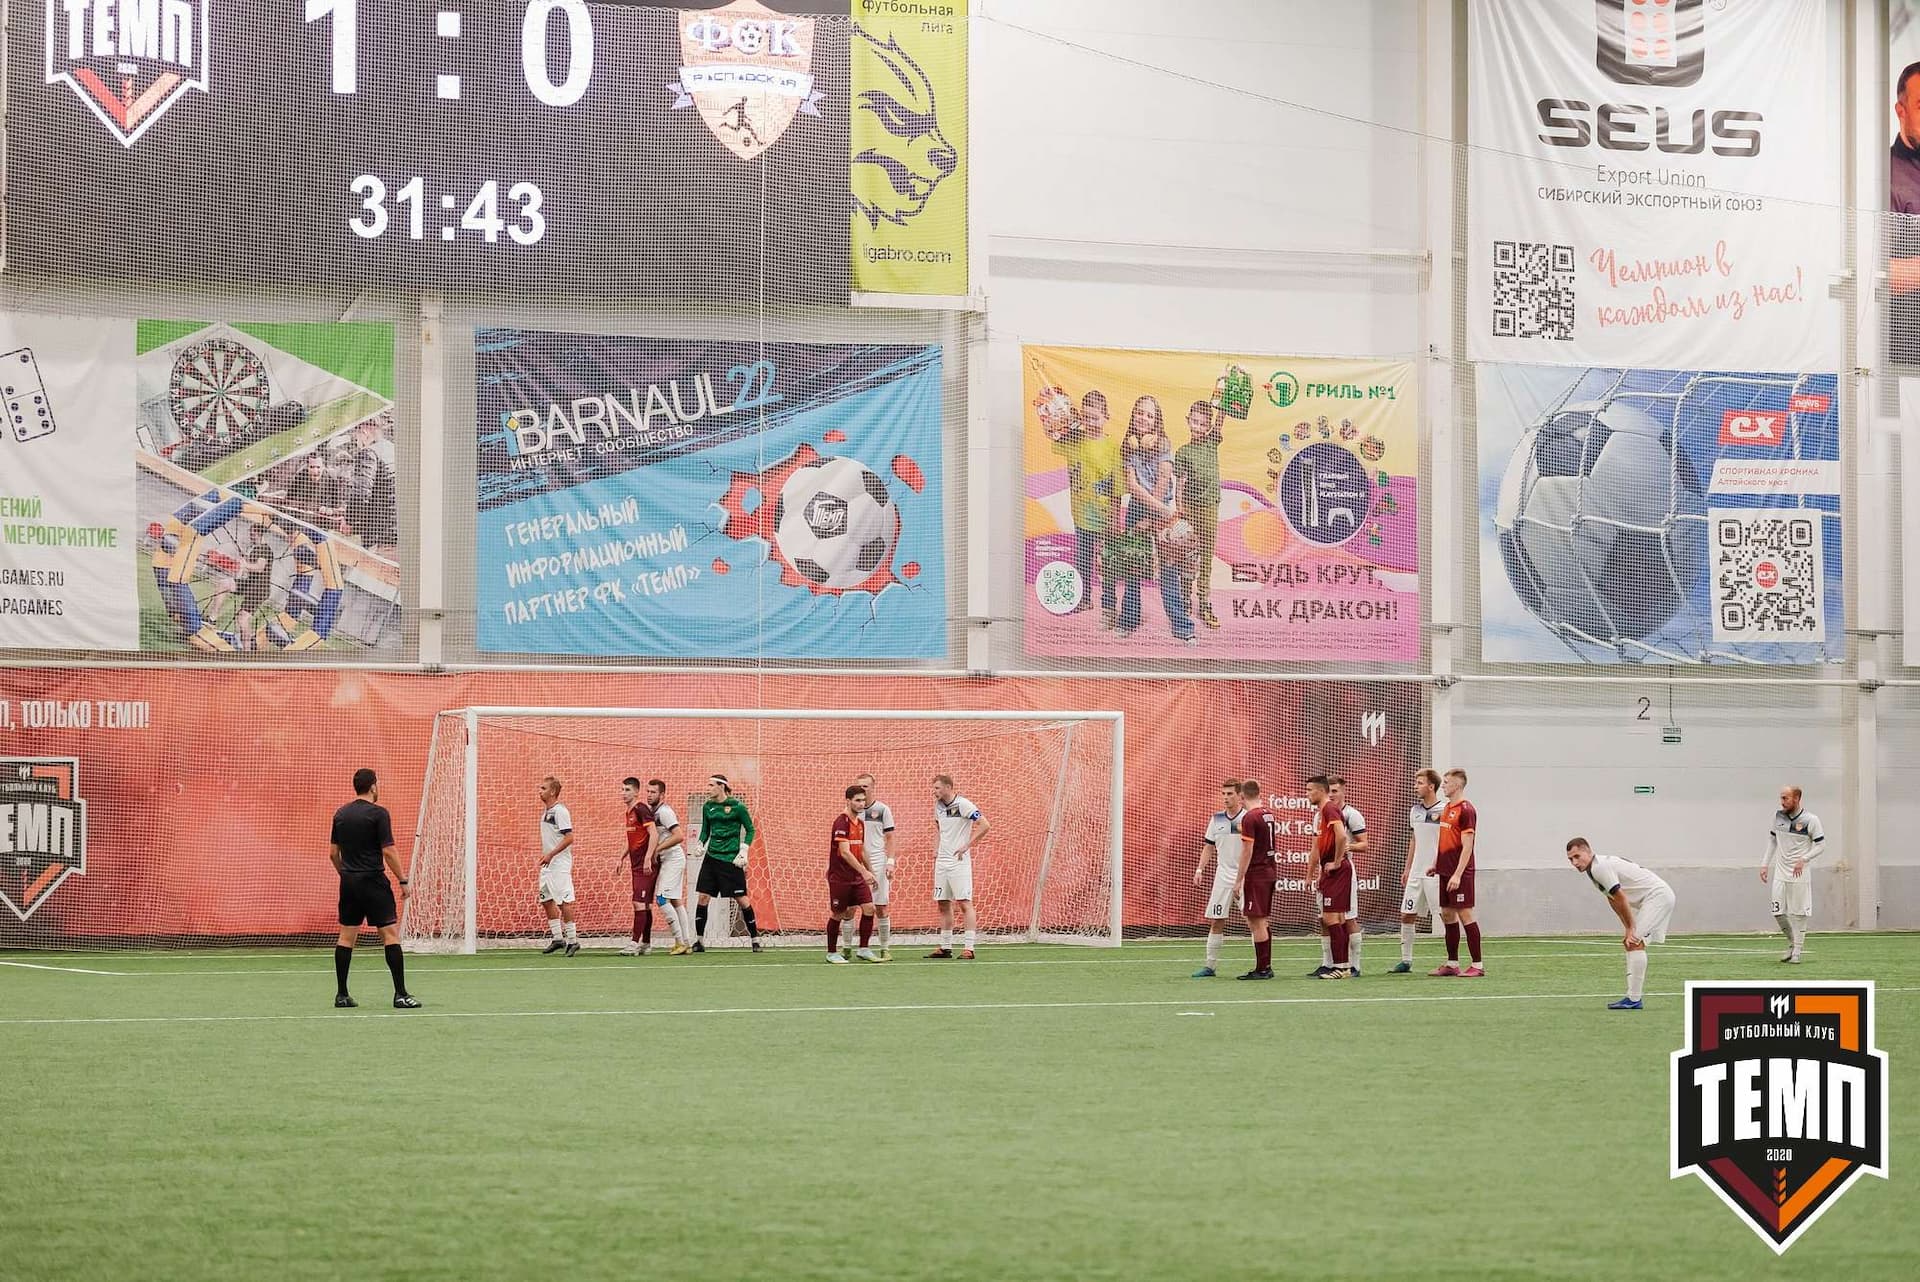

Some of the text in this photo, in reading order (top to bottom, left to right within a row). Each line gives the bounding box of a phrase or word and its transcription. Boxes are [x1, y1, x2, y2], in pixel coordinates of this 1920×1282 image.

[862, 0, 954, 16] футбольная
[63, 0, 192, 68] ТЕМП
[921, 22, 953, 35] лига
[1537, 98, 1764, 158] SEUS
[1597, 164, 1707, 188] Export Union
[349, 175, 546, 246] 31:43
[1537, 186, 1763, 212] СИБИРСКИЙ ЭКСПОРТНЫЙ СОЮЗ
[863, 243, 952, 264] ligabro.com
[1590, 240, 1734, 289] Чемпион в
[1598, 265, 1803, 328] каждом из нас!
[1306, 383, 1396, 401] ГРИЛЬ №1
[510, 447, 582, 471] ИНТЕРНЕТ
[595, 423, 694, 456] СООБЩЕСТВО
[1719, 466, 1819, 476] СПОРТИВНАЯ ХРОНИКА
[505, 494, 640, 548] ГЕНЕРАЛЬНЫЙ
[4, 524, 118, 549] МЕРОПРИЯТИЕ
[505, 523, 689, 589] ИНФОРМАЦИОННЫЙ
[0, 568, 64, 587] GAMES.RU
[1231, 563, 1383, 588] БУДЬ КРУТ,
[504, 564, 701, 625] ПАРТНЕР ФК «ТЕМП»
[1232, 598, 1398, 624] КАК ДРАКОН!
[21, 700, 91, 728] ТОЛЬКО
[97, 701, 150, 728] ТЕМП!
[1637, 696, 1651, 720] 2
[1213, 904, 1223, 916] 18
[1404, 899, 1414, 911] 19
